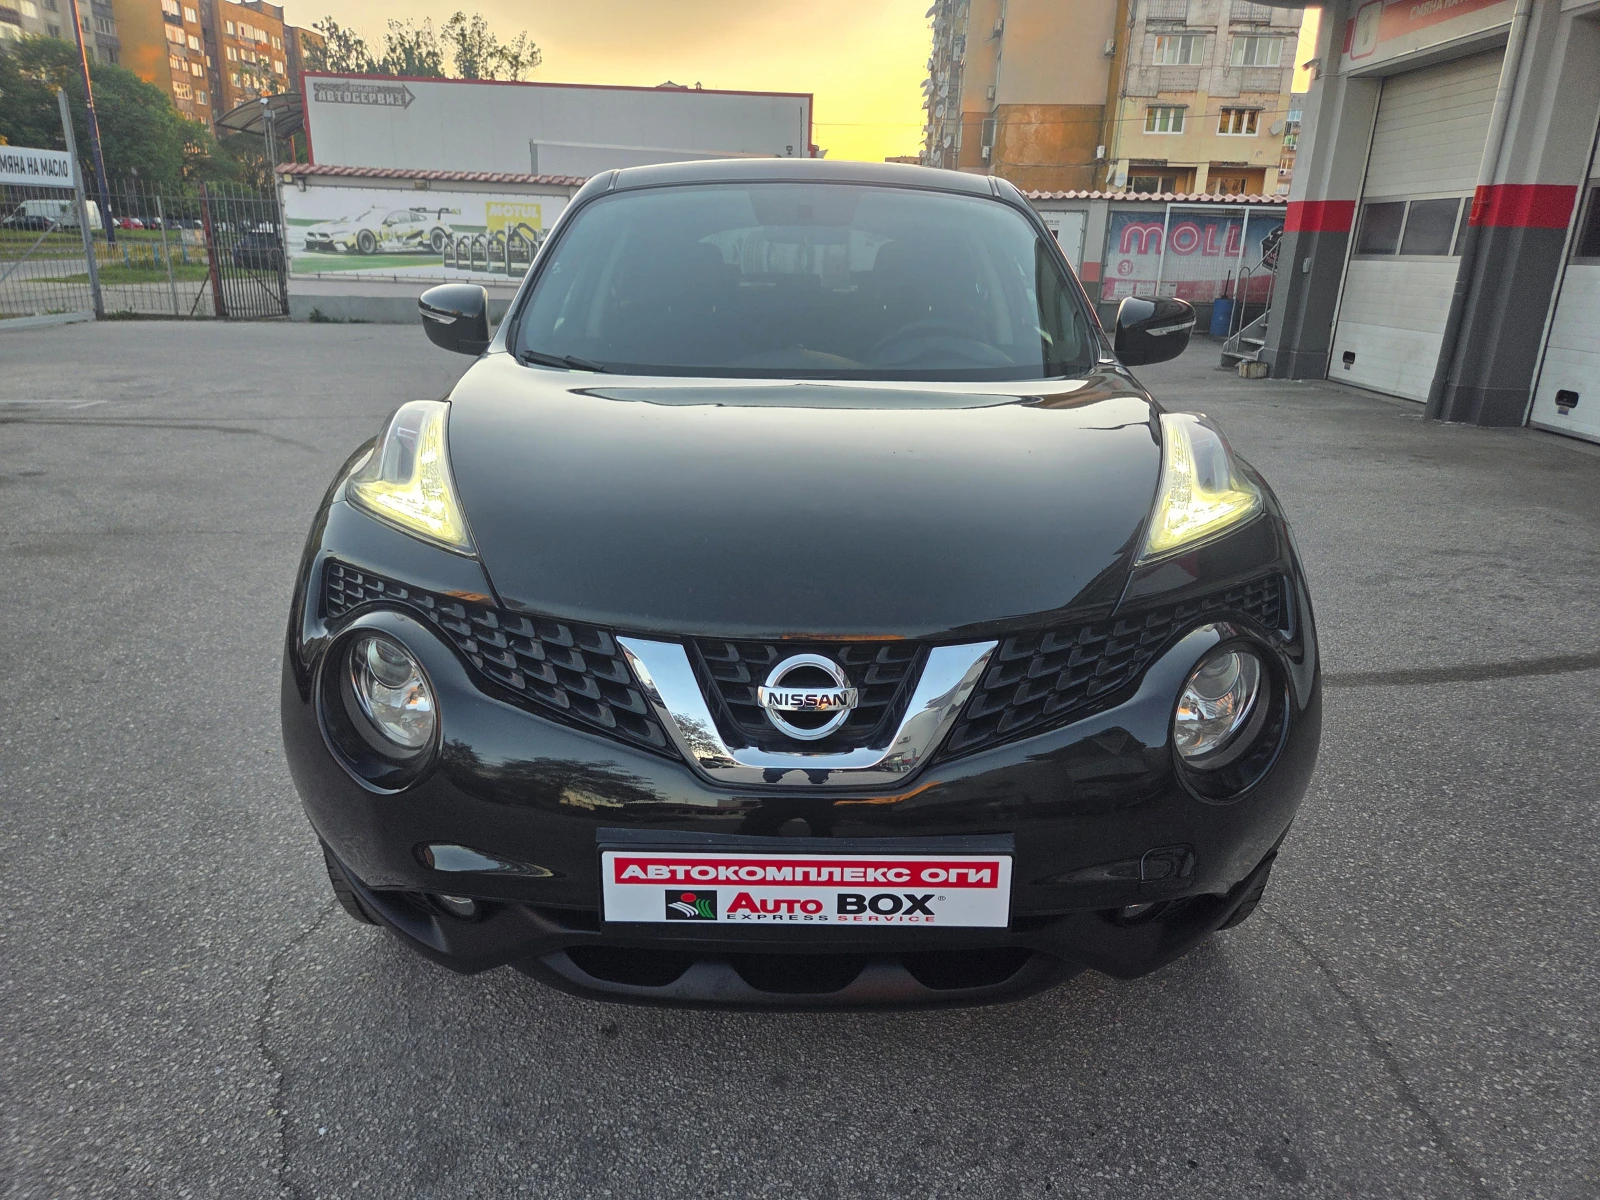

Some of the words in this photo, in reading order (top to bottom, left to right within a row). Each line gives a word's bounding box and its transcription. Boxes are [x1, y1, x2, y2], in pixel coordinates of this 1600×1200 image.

[317, 90, 403, 105] АВТОСЕРВИЗ
[27, 156, 40, 176] НА
[41, 157, 69, 178] МАСЛО
[488, 204, 539, 219] MOTUL
[768, 692, 847, 707] NISSAN
[620, 864, 911, 883] АВТОКОМПЛЕКС
[920, 867, 992, 883] ОГИ
[726, 914, 829, 922] EXPRESS
